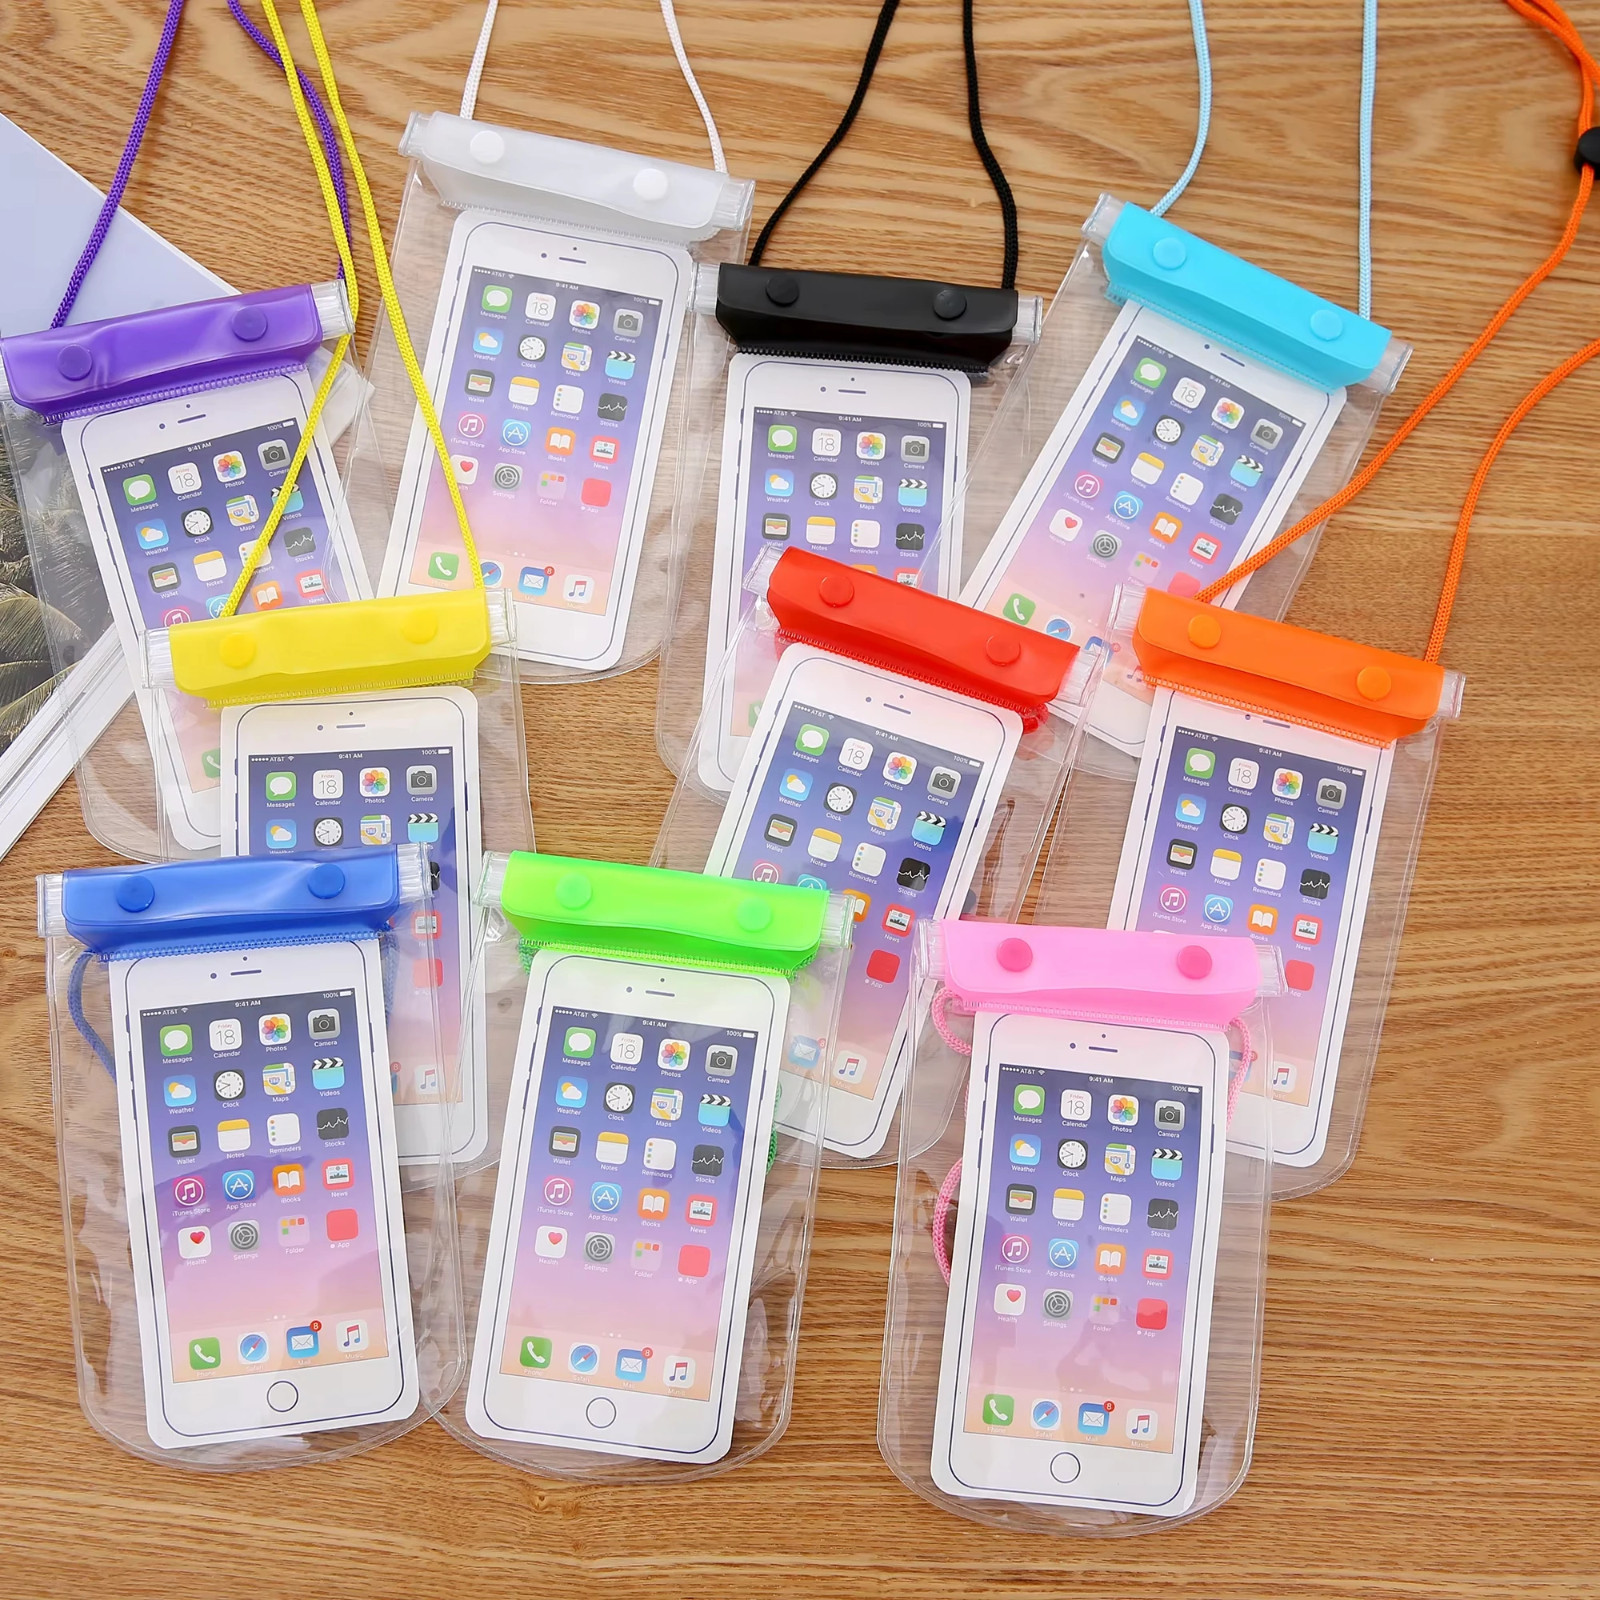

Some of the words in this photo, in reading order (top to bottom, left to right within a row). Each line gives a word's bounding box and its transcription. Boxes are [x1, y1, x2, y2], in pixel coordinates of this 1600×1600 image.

[530, 301, 550, 316] 18
[1177, 385, 1198, 404] 18
[818, 437, 835, 452] 18
[175, 472, 196, 489] 18
[844, 746, 866, 766] 18
[1233, 767, 1253, 784] 18
[319, 779, 337, 794] 18
[216, 1029, 236, 1046] 18
[214, 1050, 241, 1058] Calendar
[616, 1042, 636, 1060] 18
[611, 1063, 637, 1072] Calendar
[660, 1070, 682, 1078] Photos
[707, 1076, 730, 1084] Camera
[169, 1106, 195, 1114] Weather
[1066, 1099, 1086, 1116] 18
[1062, 1120, 1088, 1128] Calendar
[270, 1145, 302, 1154] Reminders
[642, 1169, 673, 1178] Reminders
